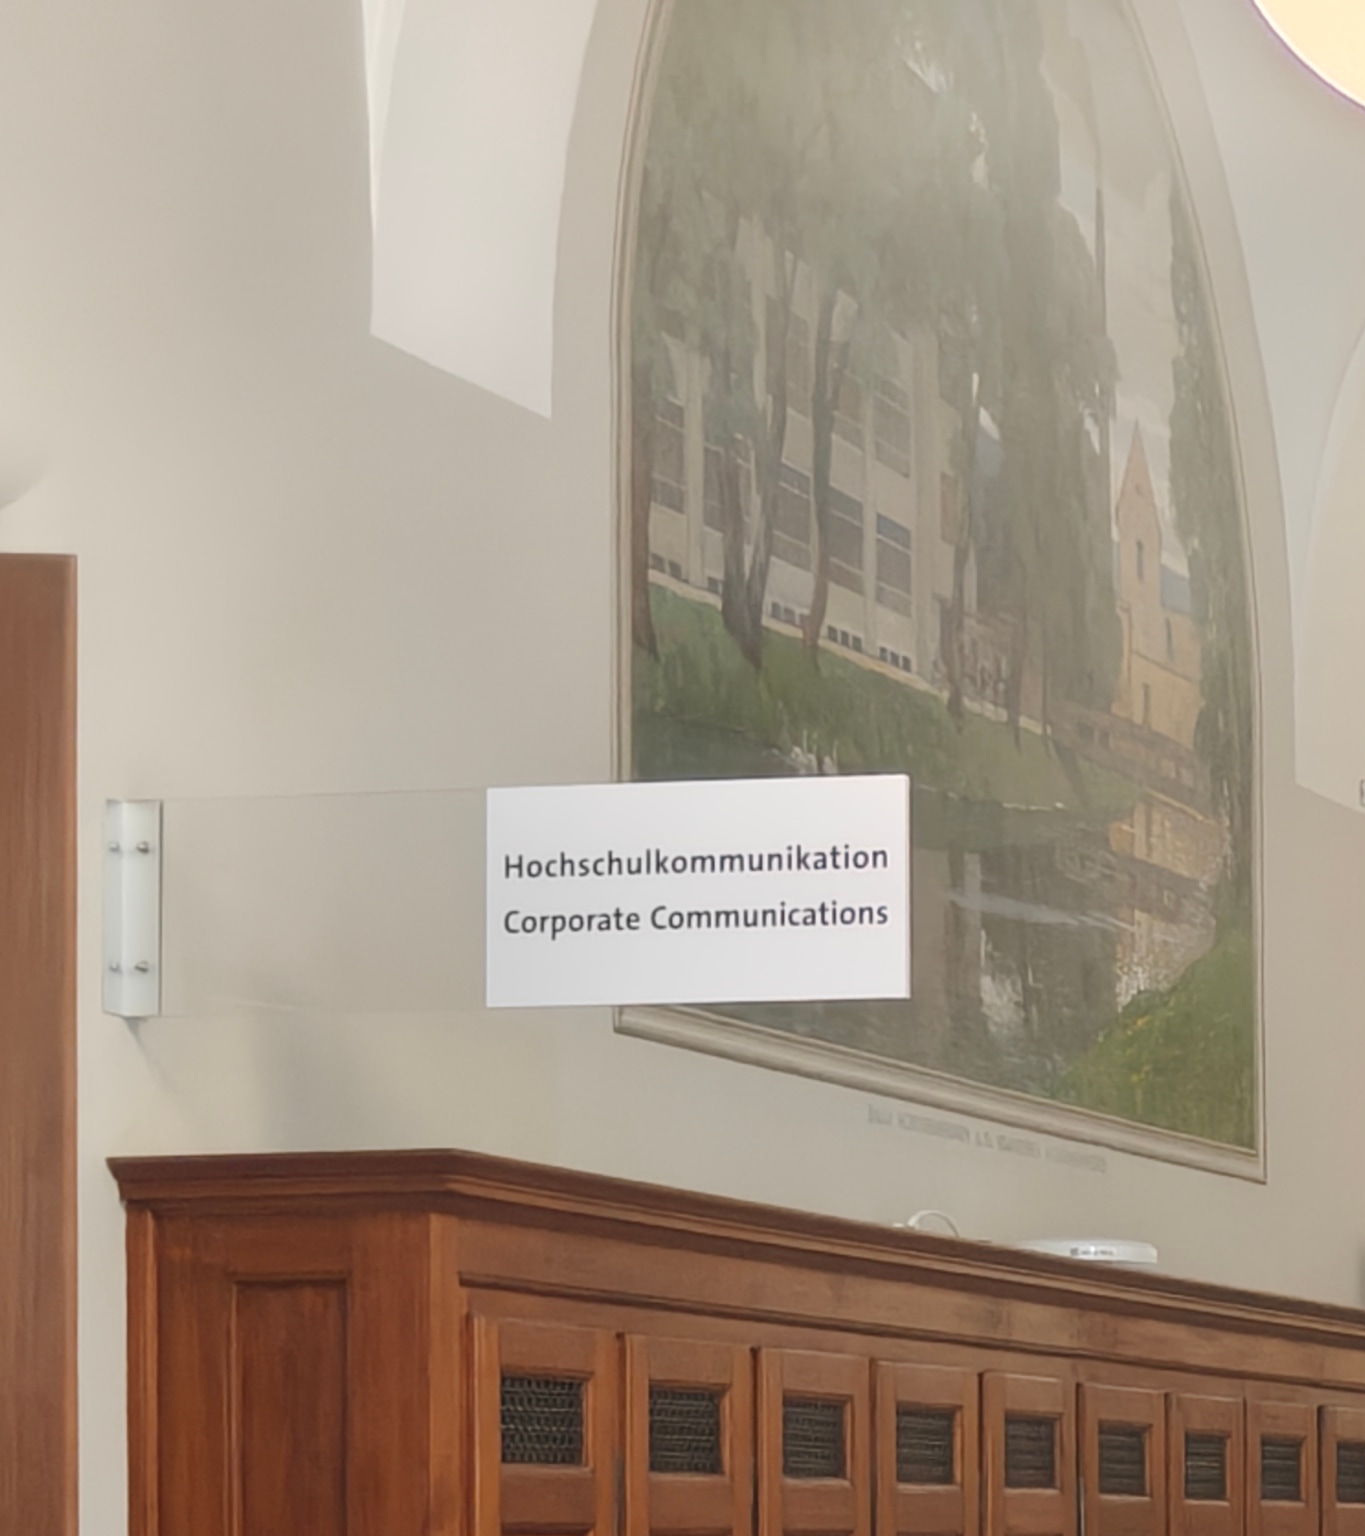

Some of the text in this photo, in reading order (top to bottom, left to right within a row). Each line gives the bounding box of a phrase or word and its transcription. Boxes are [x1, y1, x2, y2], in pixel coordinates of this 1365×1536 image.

[503, 844, 889, 879] Hochschulkommunikation
[503, 900, 889, 941] Corporate Communications
